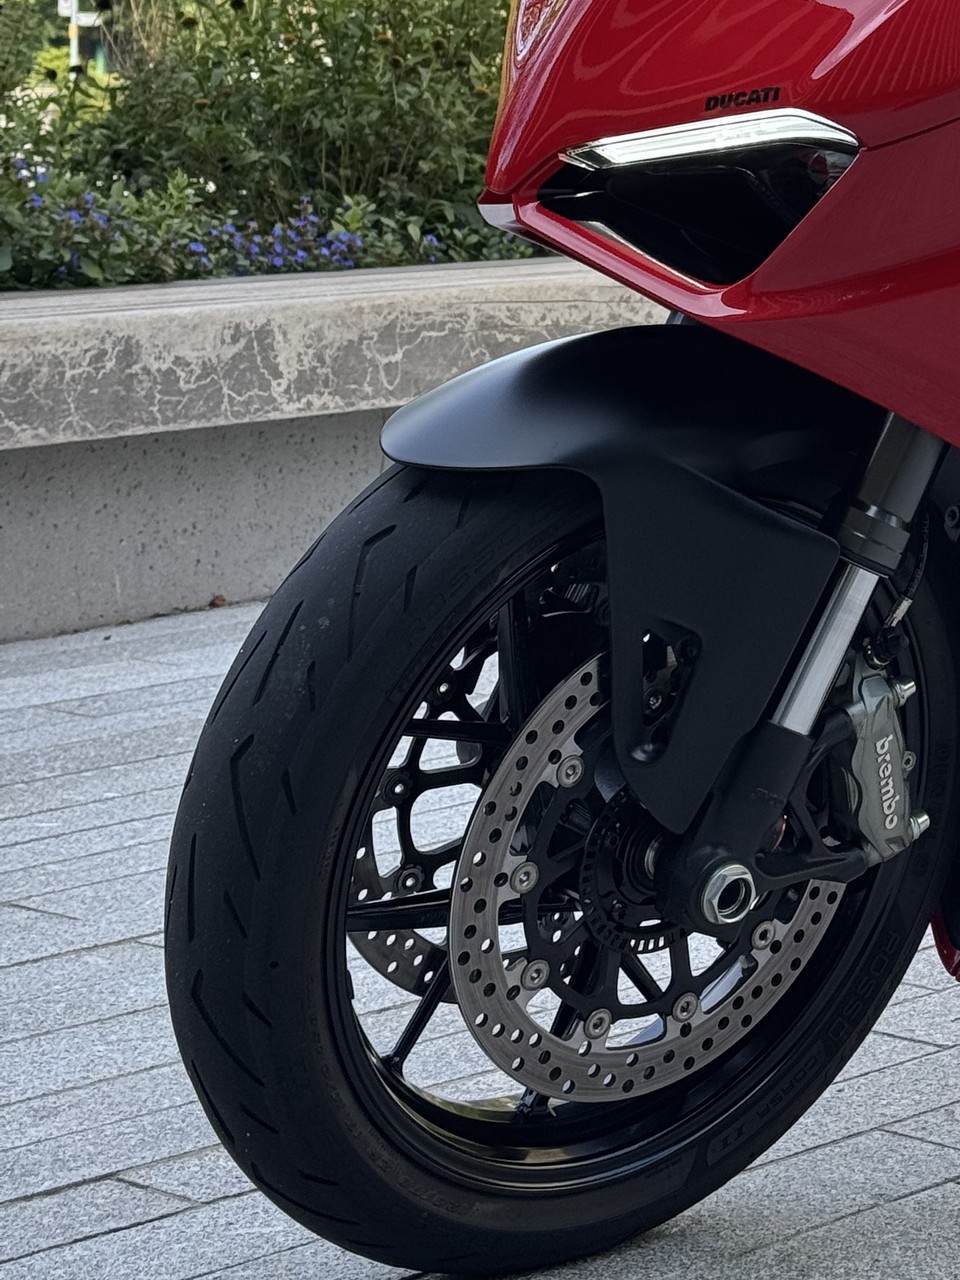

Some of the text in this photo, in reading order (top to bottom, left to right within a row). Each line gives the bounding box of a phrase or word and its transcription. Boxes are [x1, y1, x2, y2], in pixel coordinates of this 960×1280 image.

[704, 86, 781, 112] DUCATI
[875, 733, 900, 830] brembo
[828, 929, 901, 1041] ROSSO
[756, 1055, 818, 1119] CORSA
